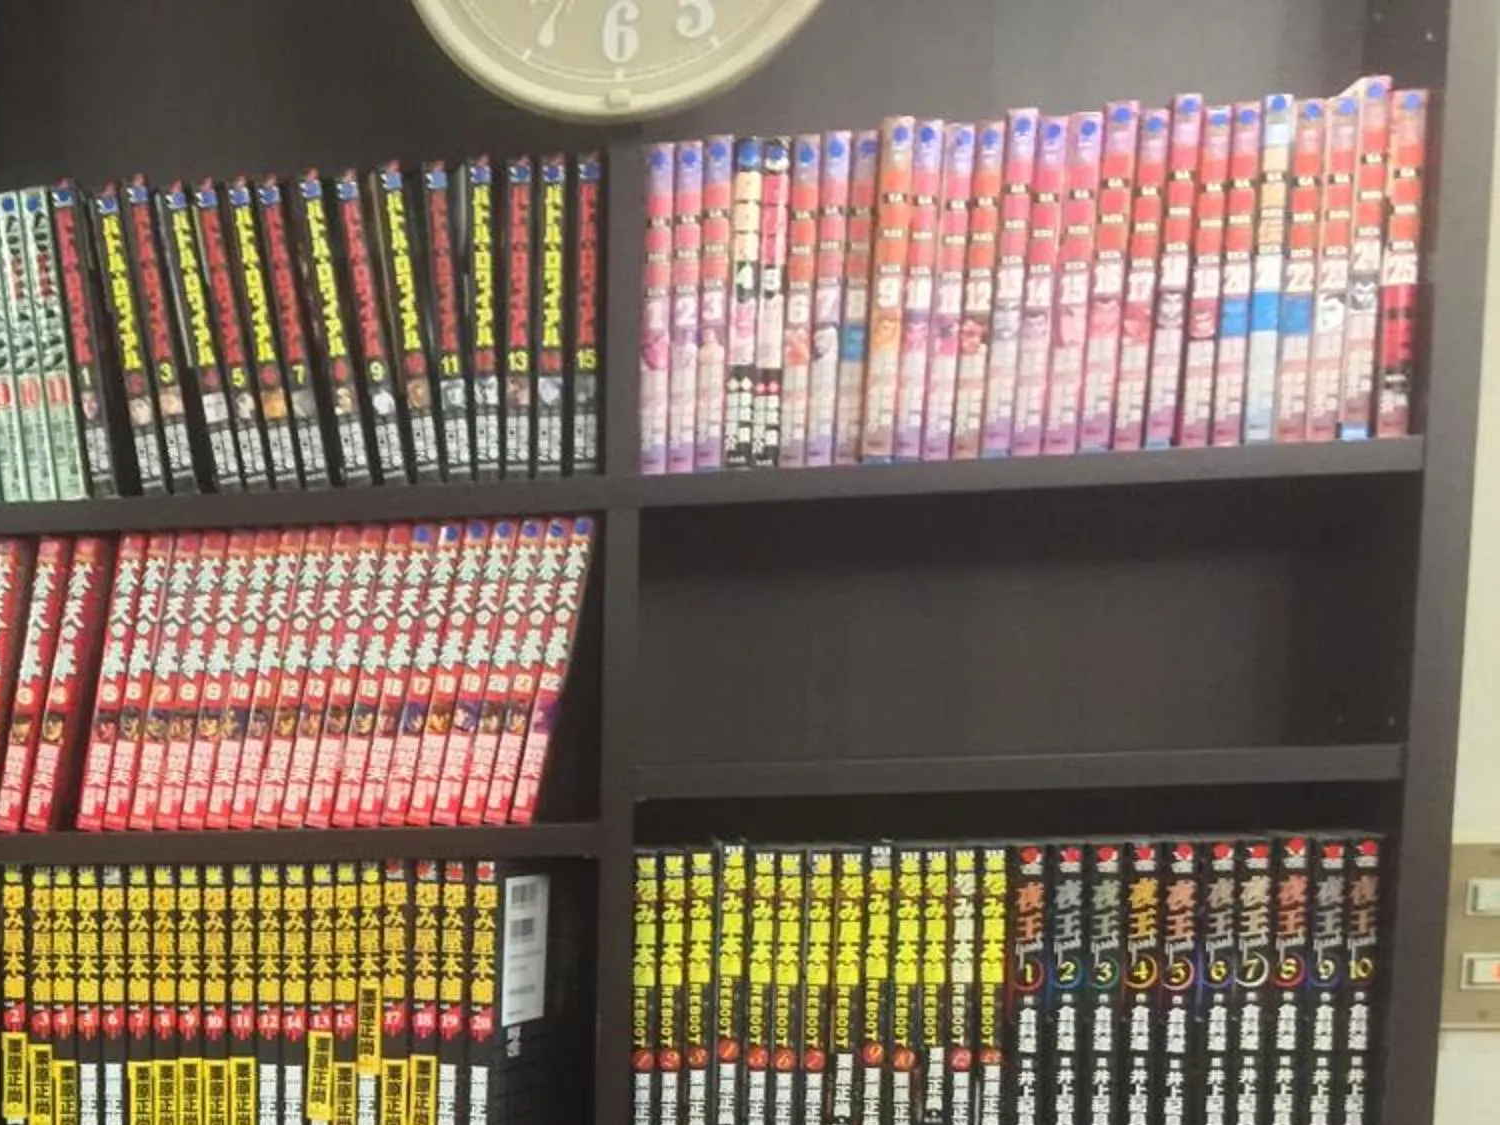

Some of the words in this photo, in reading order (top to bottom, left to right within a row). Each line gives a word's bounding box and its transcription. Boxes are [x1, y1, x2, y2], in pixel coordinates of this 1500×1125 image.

[602, 0, 639, 64] 6
[1280, 961, 1295, 979] 8
[1318, 960, 1334, 979] 9
[1350, 958, 1372, 978] 10
[634, 986, 647, 1048] REBOOT
[662, 985, 674, 1048] REBOOT
[719, 978, 732, 1038] REBOOT
[751, 984, 763, 1046] REBOOT
[776, 985, 789, 1048] REBOOT
[806, 985, 818, 1048] REBOOT
